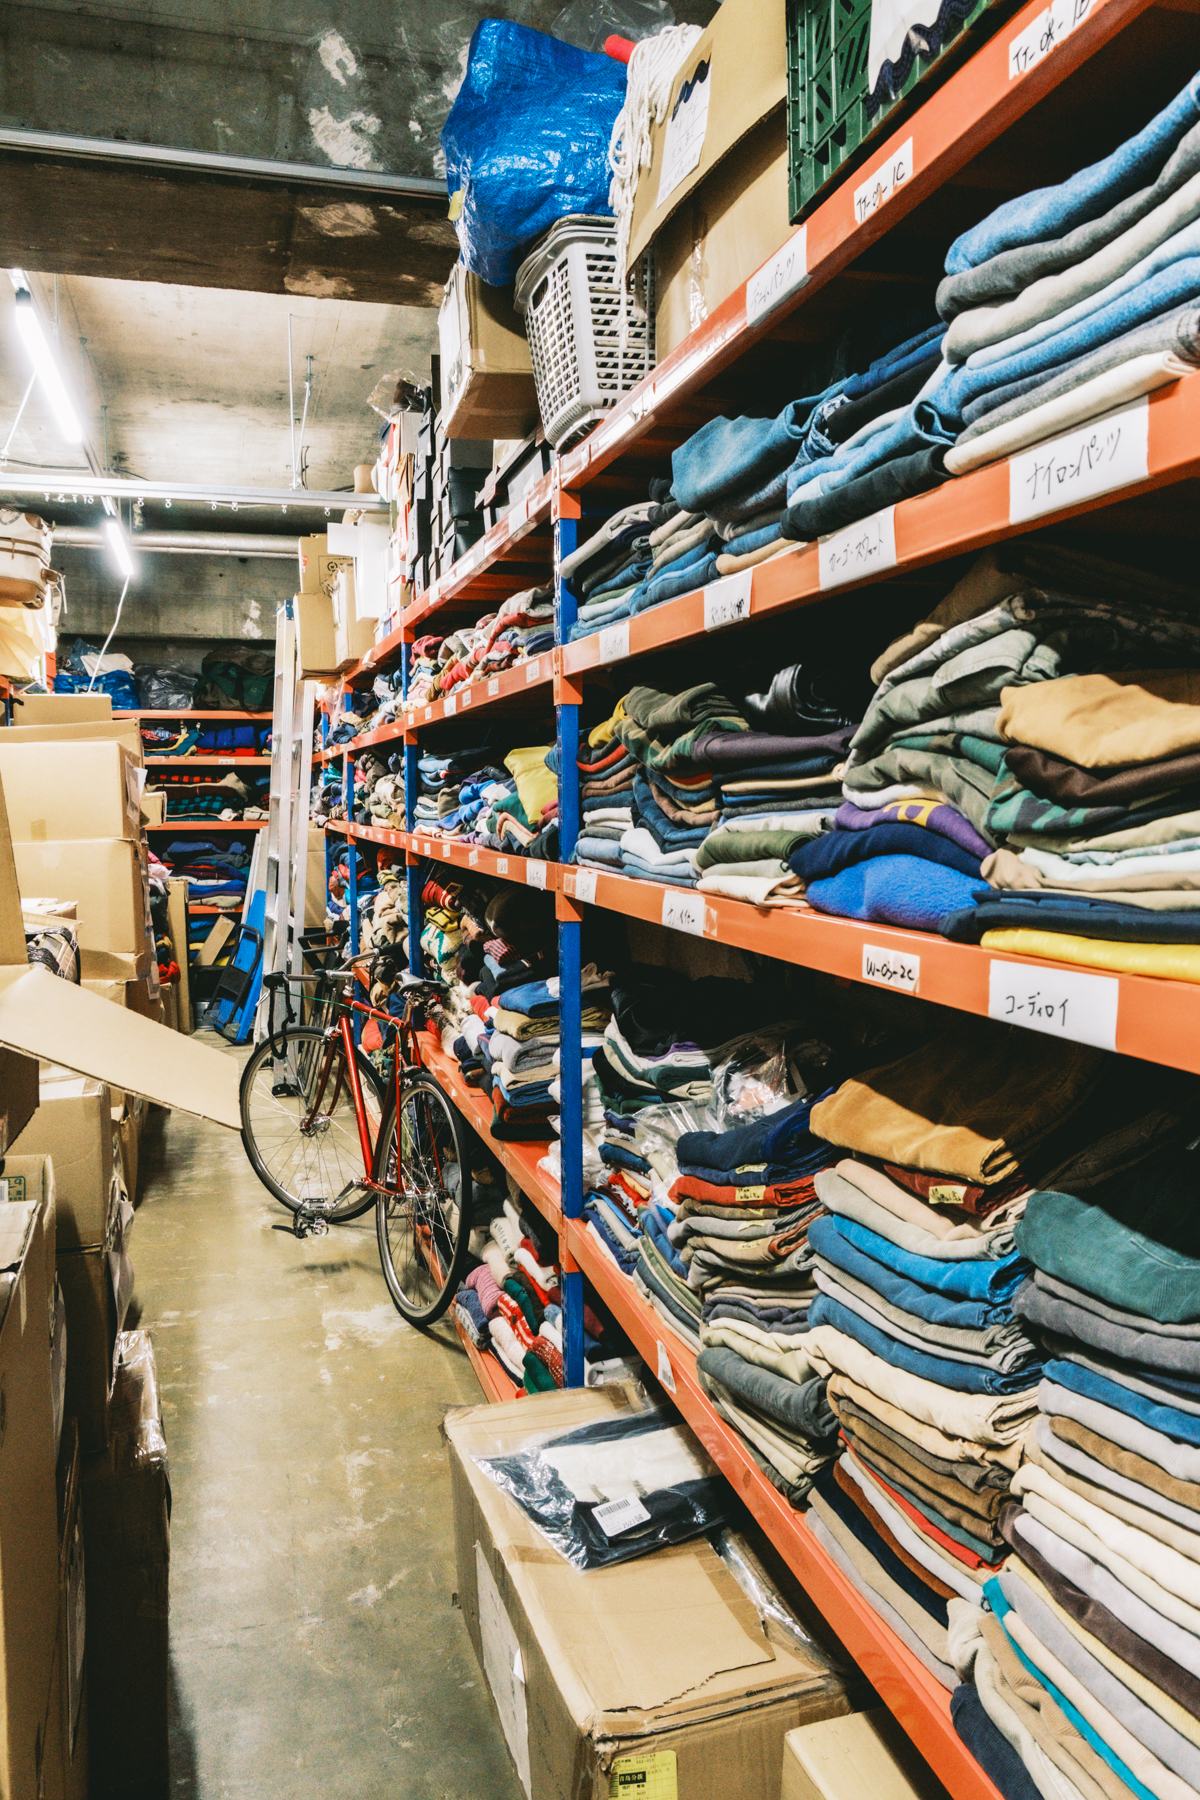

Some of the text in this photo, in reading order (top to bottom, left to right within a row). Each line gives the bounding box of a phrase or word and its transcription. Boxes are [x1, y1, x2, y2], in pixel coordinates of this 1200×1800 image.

[1026, 427, 1121, 500] ナイロンパンツ
[1005, 991, 1069, 1027] コーディロイ
